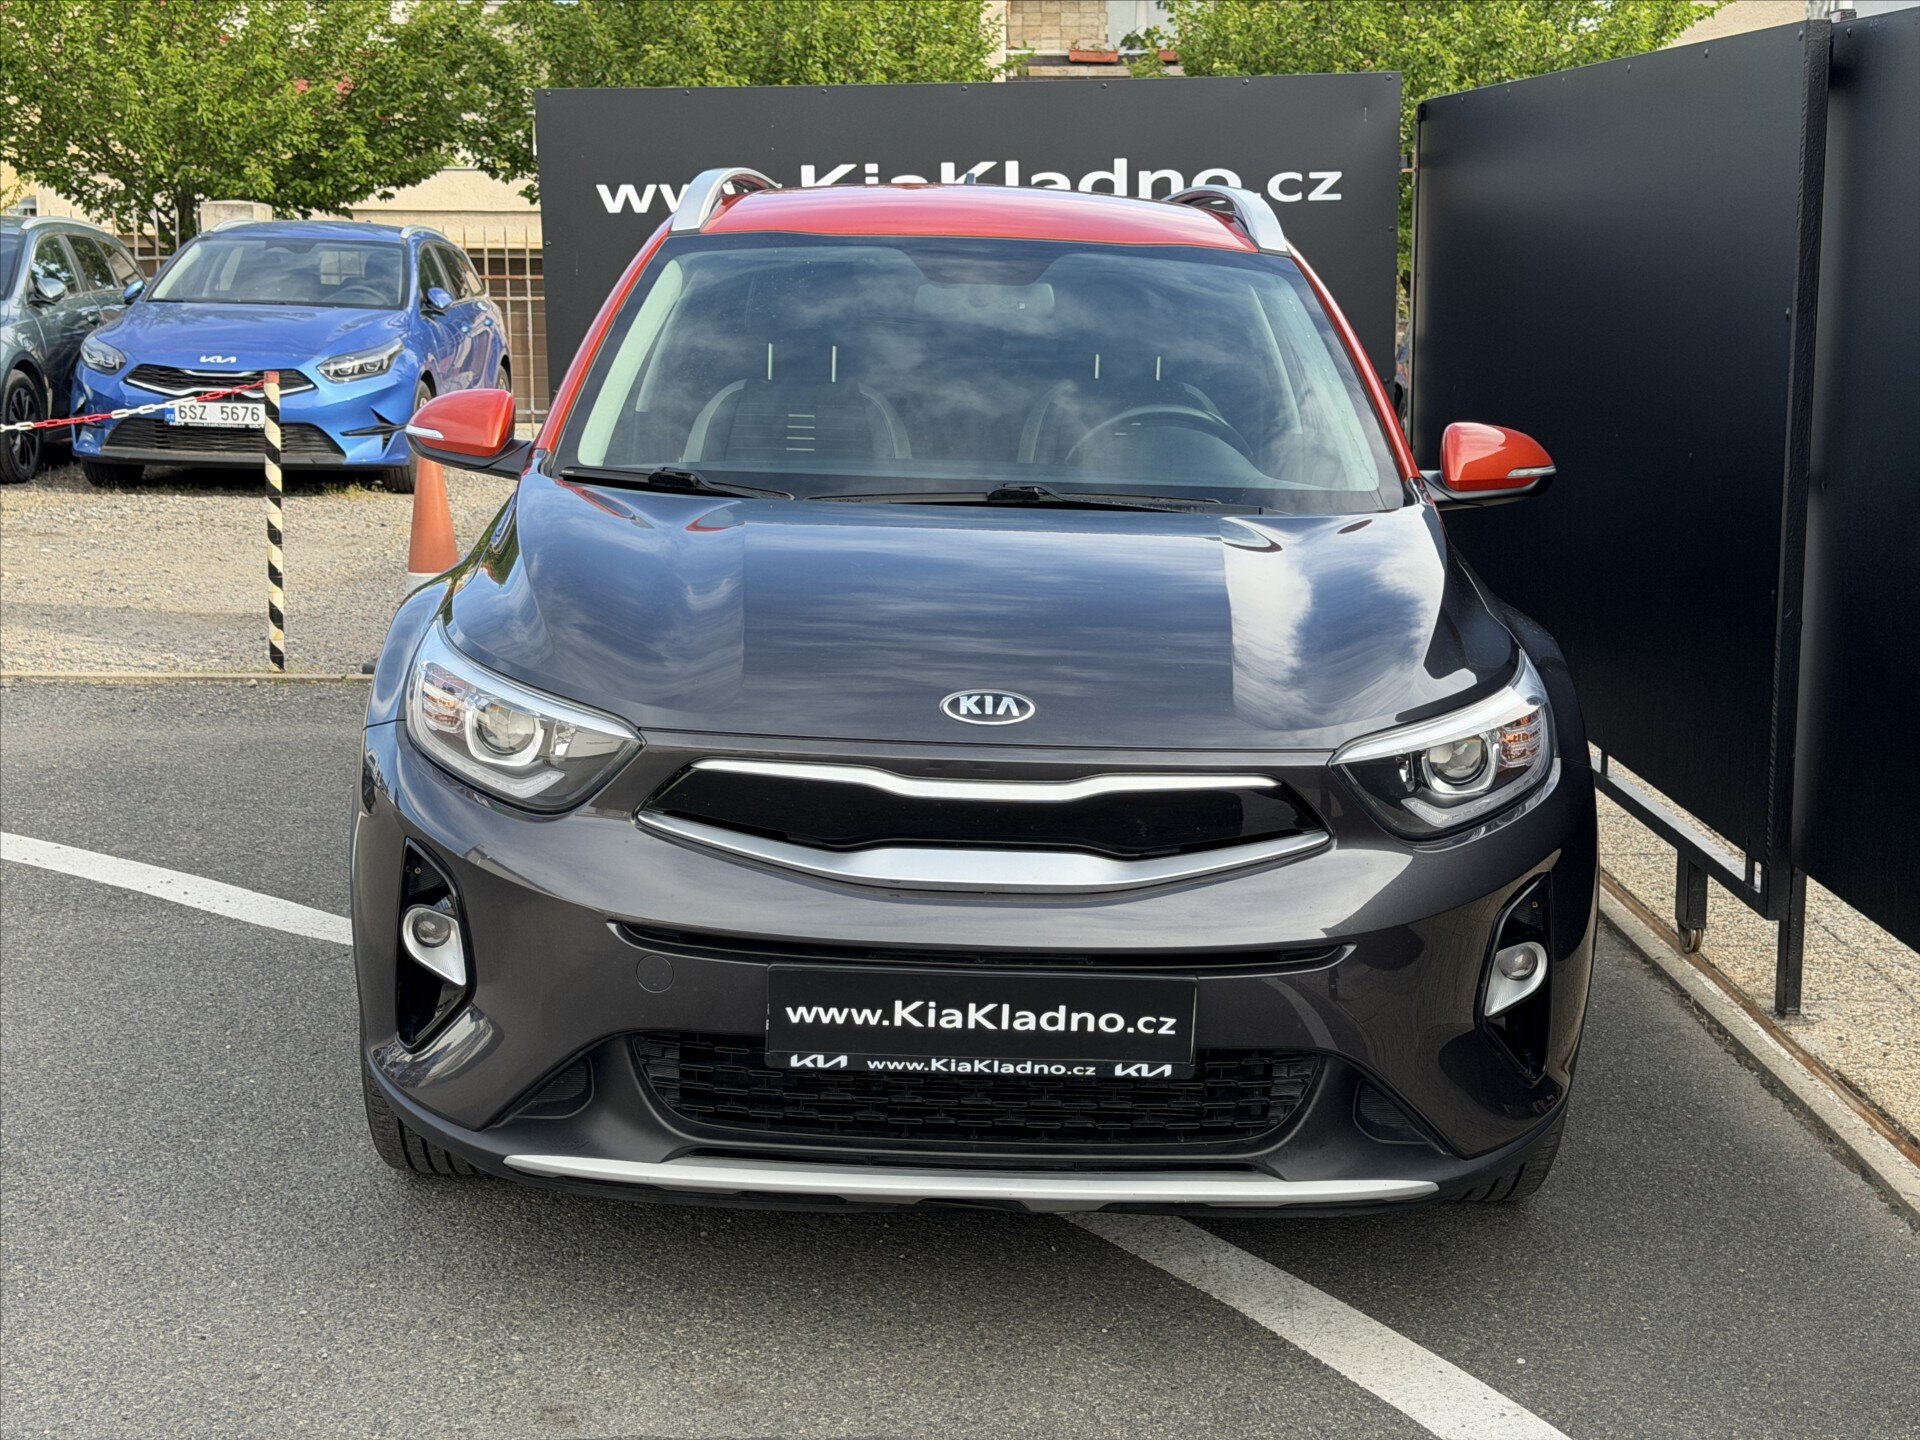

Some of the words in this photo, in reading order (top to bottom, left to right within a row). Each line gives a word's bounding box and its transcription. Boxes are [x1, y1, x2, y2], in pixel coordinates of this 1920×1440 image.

[178, 405, 208, 421] 6SZ
[220, 405, 260, 422] 5676
[958, 695, 1020, 717] KIA
[785, 999, 1177, 1036] www.KiaKladno.cz
[790, 1053, 848, 1069] KIA
[866, 1057, 1097, 1077] www.KiaKladno.cz
[1114, 1062, 1173, 1078] KIA
